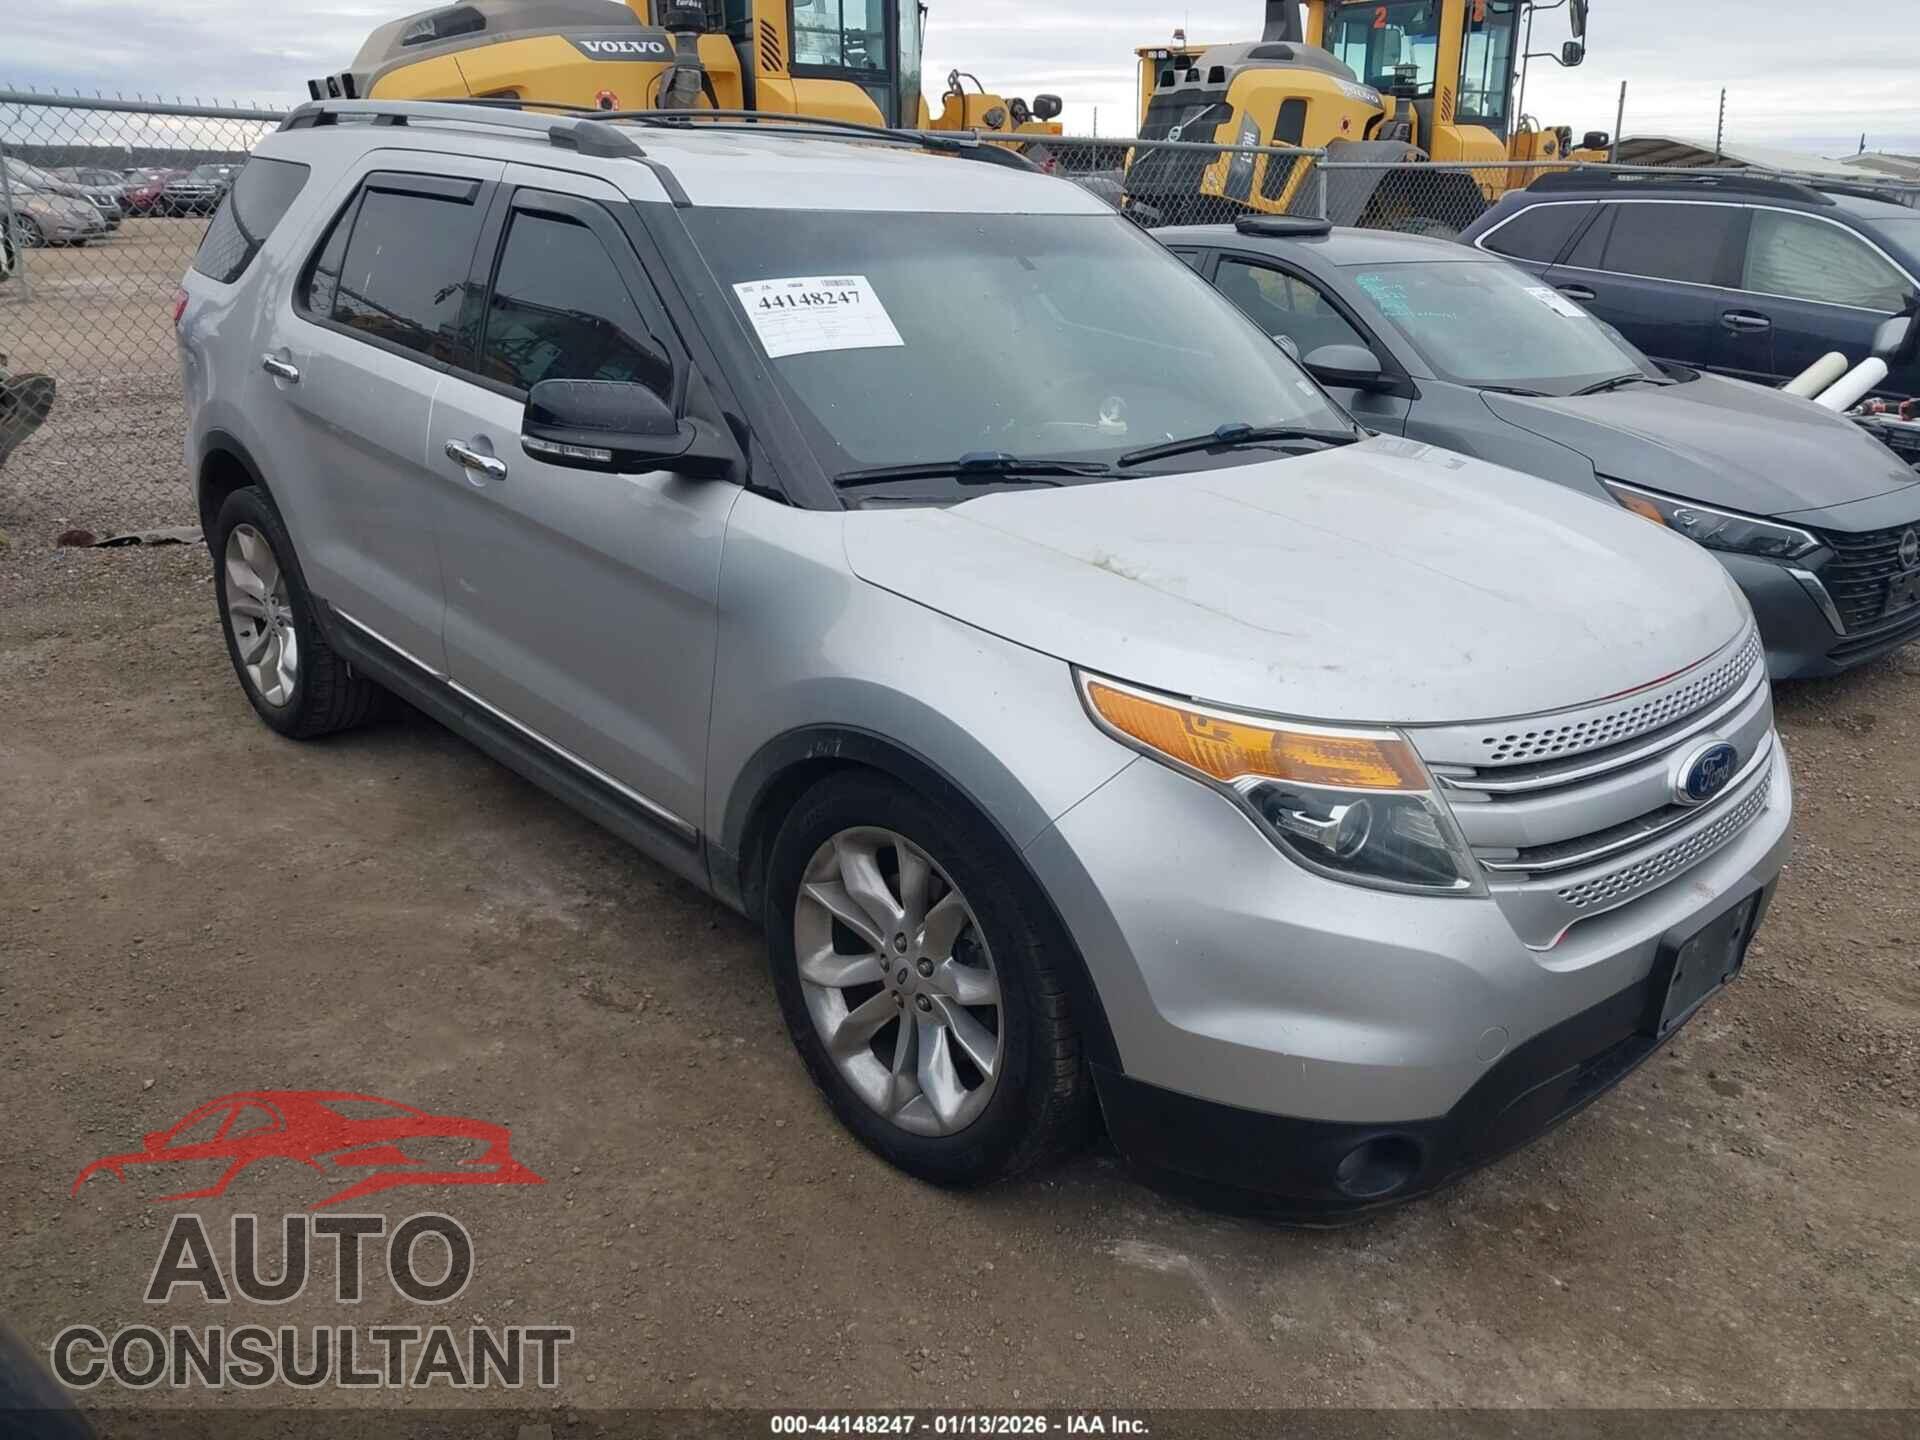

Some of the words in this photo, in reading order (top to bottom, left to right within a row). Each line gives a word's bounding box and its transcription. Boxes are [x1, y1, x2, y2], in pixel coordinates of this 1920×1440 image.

[1373, 5, 1387, 29] 2
[580, 40, 665, 54] VOLVO
[759, 290, 860, 310] 44148247
